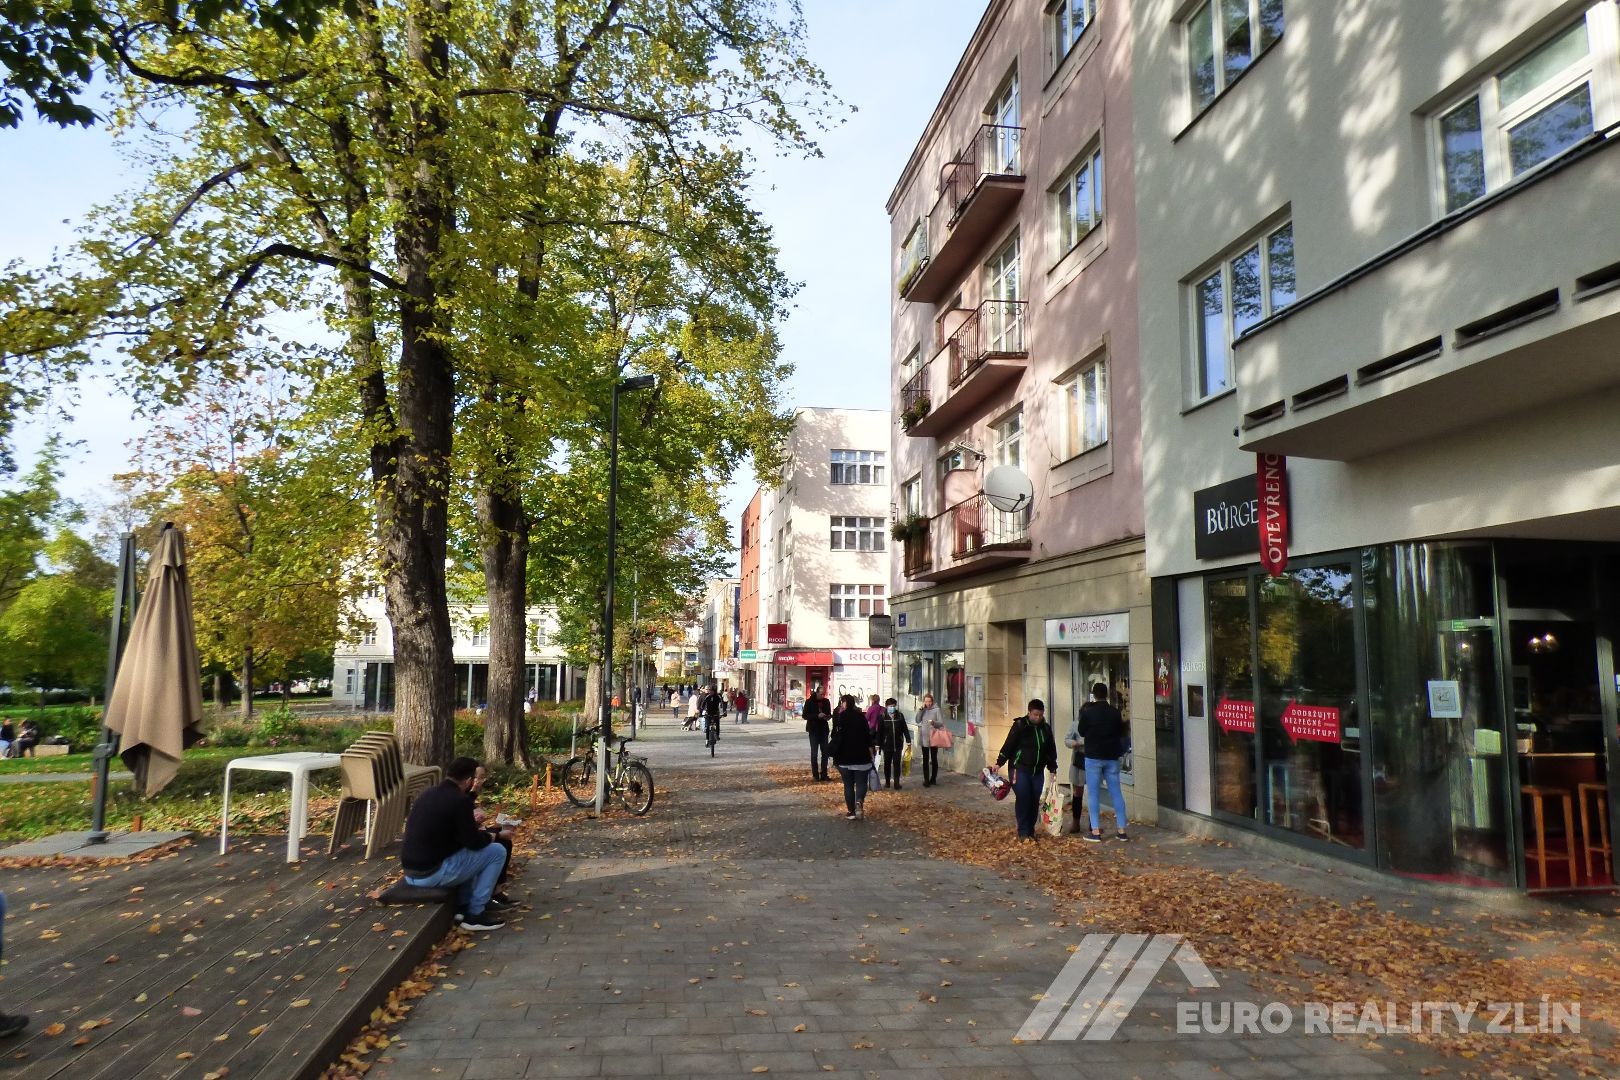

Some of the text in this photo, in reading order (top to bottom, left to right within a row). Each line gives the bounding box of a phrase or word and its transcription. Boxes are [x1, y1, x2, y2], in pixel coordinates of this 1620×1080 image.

[1207, 500, 1259, 535] BŮRGE
[1264, 454, 1282, 563] OTEVŘENO
[849, 653, 891, 662] RICOH
